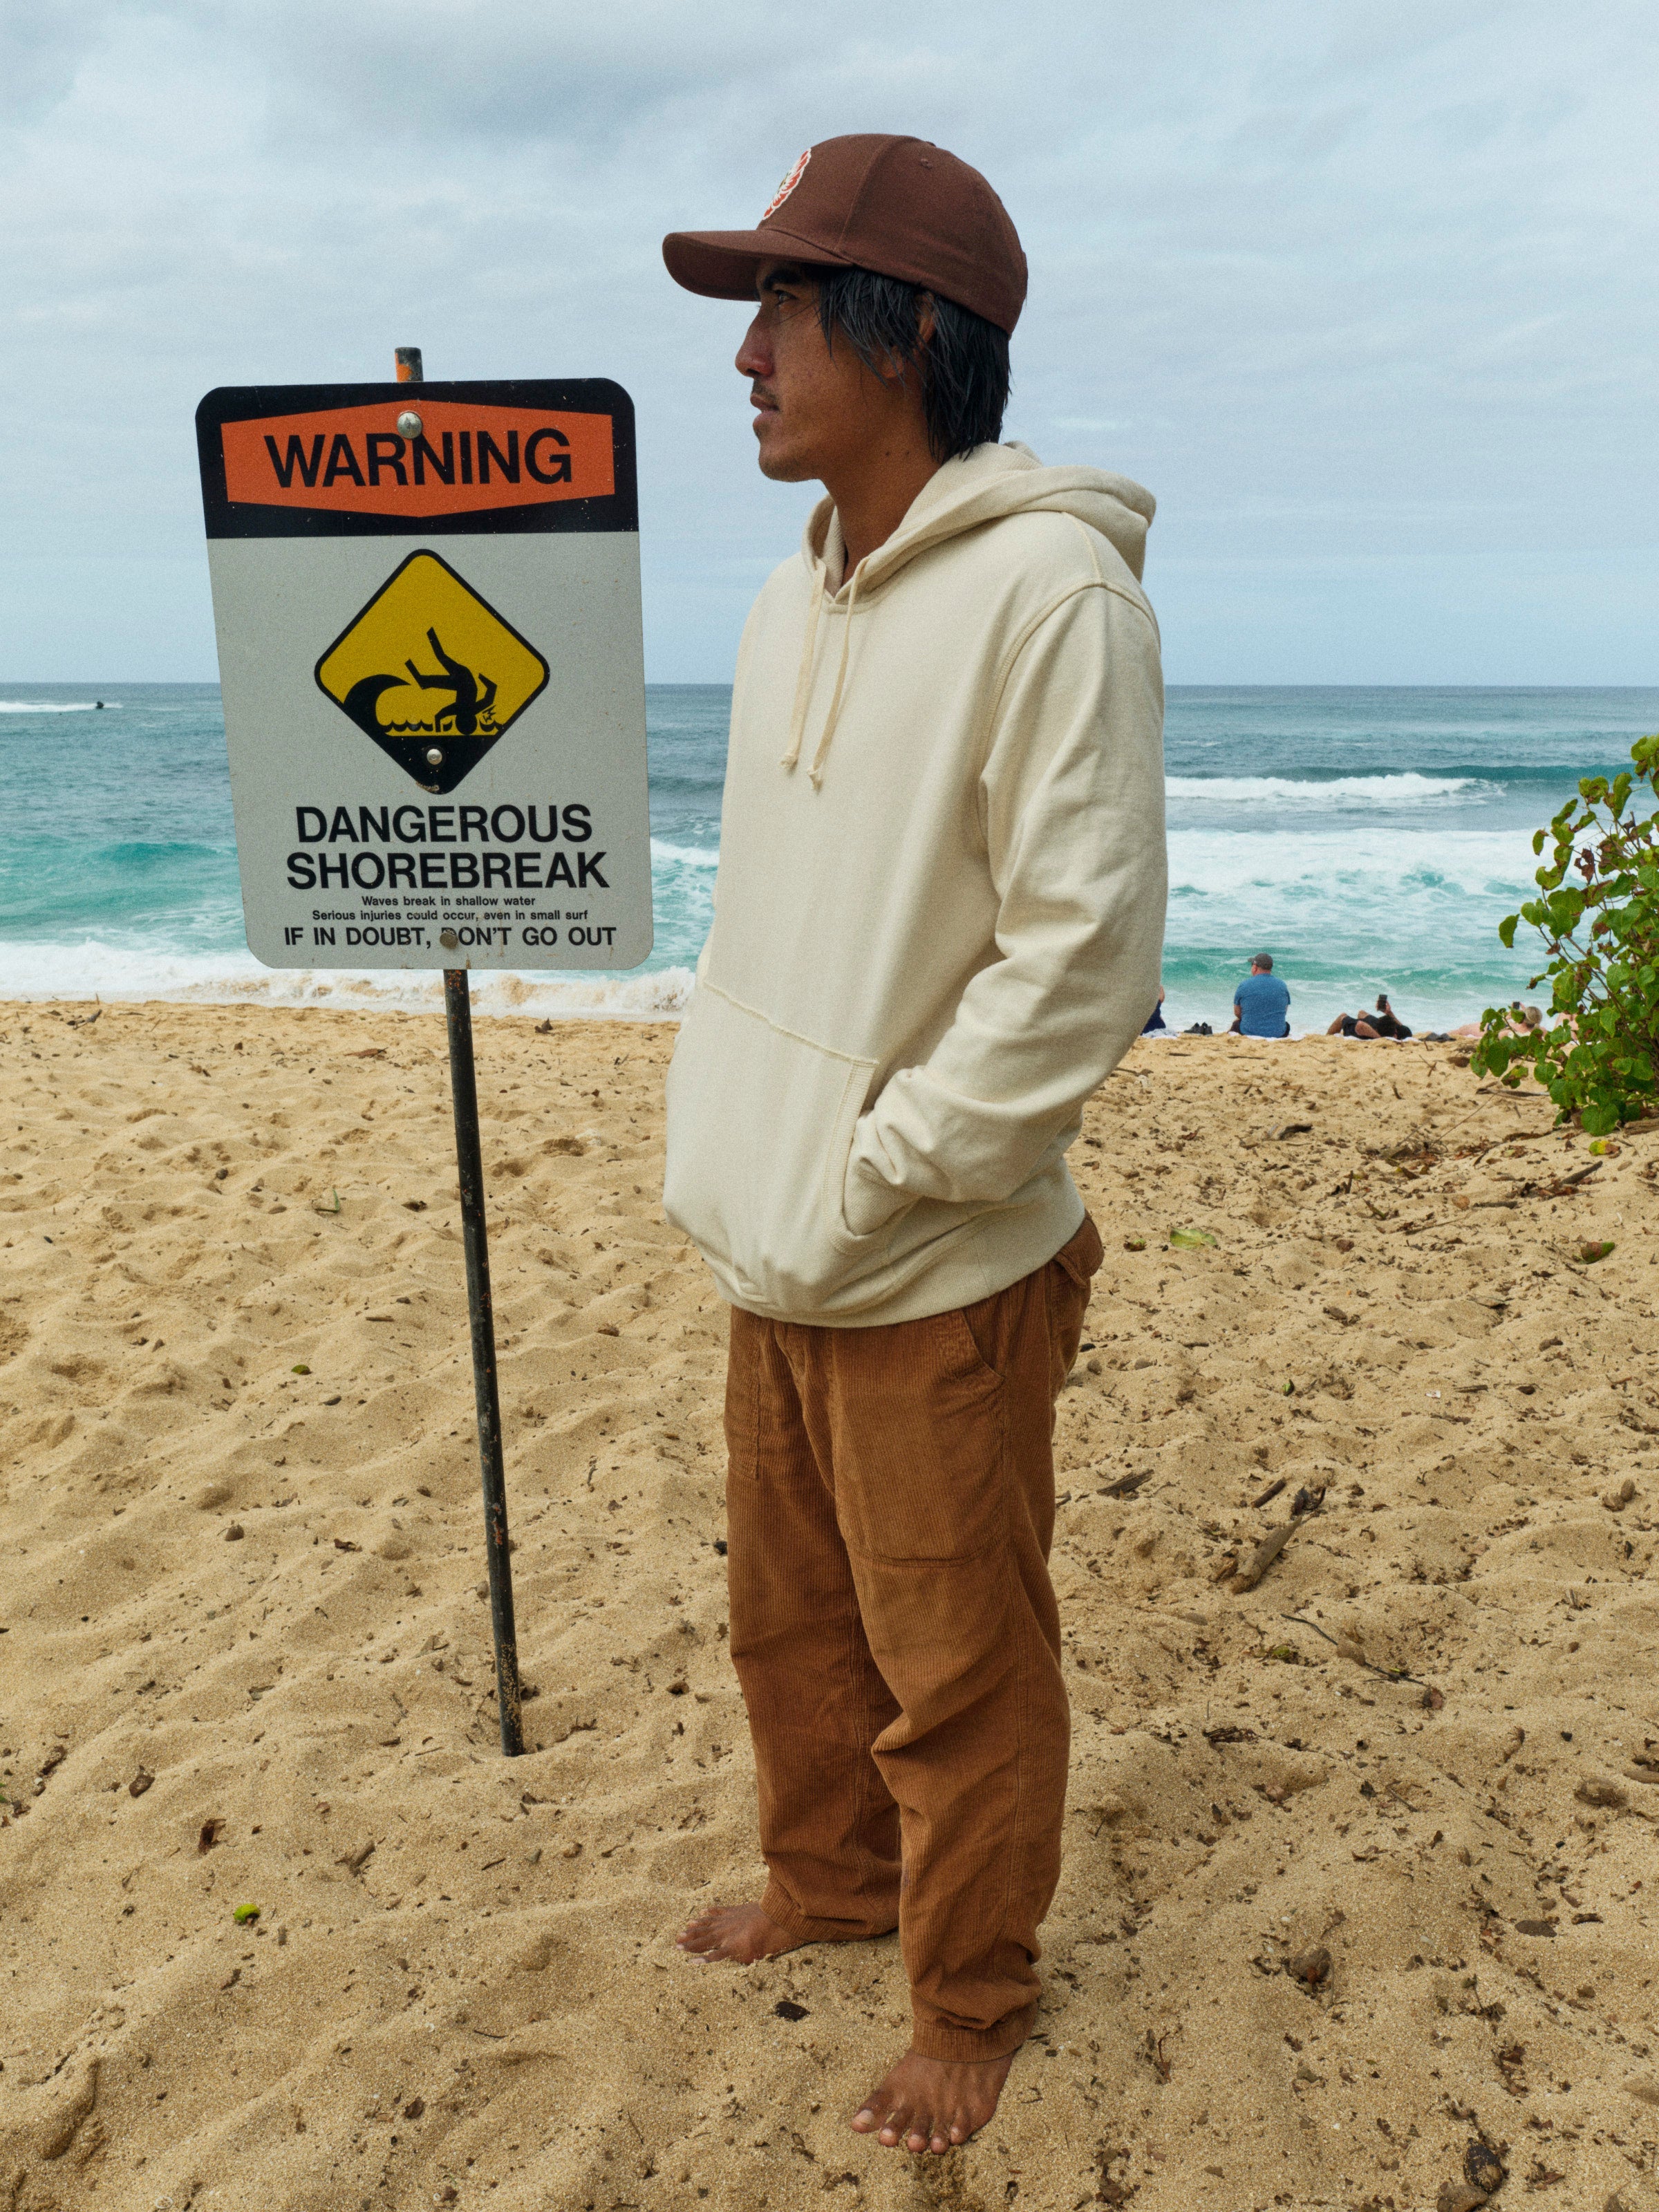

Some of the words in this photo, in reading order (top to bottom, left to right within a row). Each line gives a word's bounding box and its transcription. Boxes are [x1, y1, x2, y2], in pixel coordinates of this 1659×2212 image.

[264, 428, 572, 488] WARNING
[296, 804, 592, 843] DANGEROUS
[286, 852, 610, 890] SHOREBREAK
[312, 910, 355, 921] Serious
[360, 910, 402, 922] injuries
[406, 910, 438, 920] could
[442, 912, 479, 922] occur,
[484, 911, 511, 920] even
[515, 910, 525, 920] in
[530, 910, 560, 920] small
[565, 910, 588, 920] surf
[362, 896, 399, 906] Waves
[403, 896, 436, 906] break
[440, 896, 451, 906] in
[456, 896, 498, 906] shallow
[503, 897, 536, 906] water
[284, 927, 303, 946] IF
[313, 927, 336, 946] IN
[346, 926, 431, 949] DOUBT,
[522, 926, 558, 946] GO
[568, 926, 617, 946] OUT
